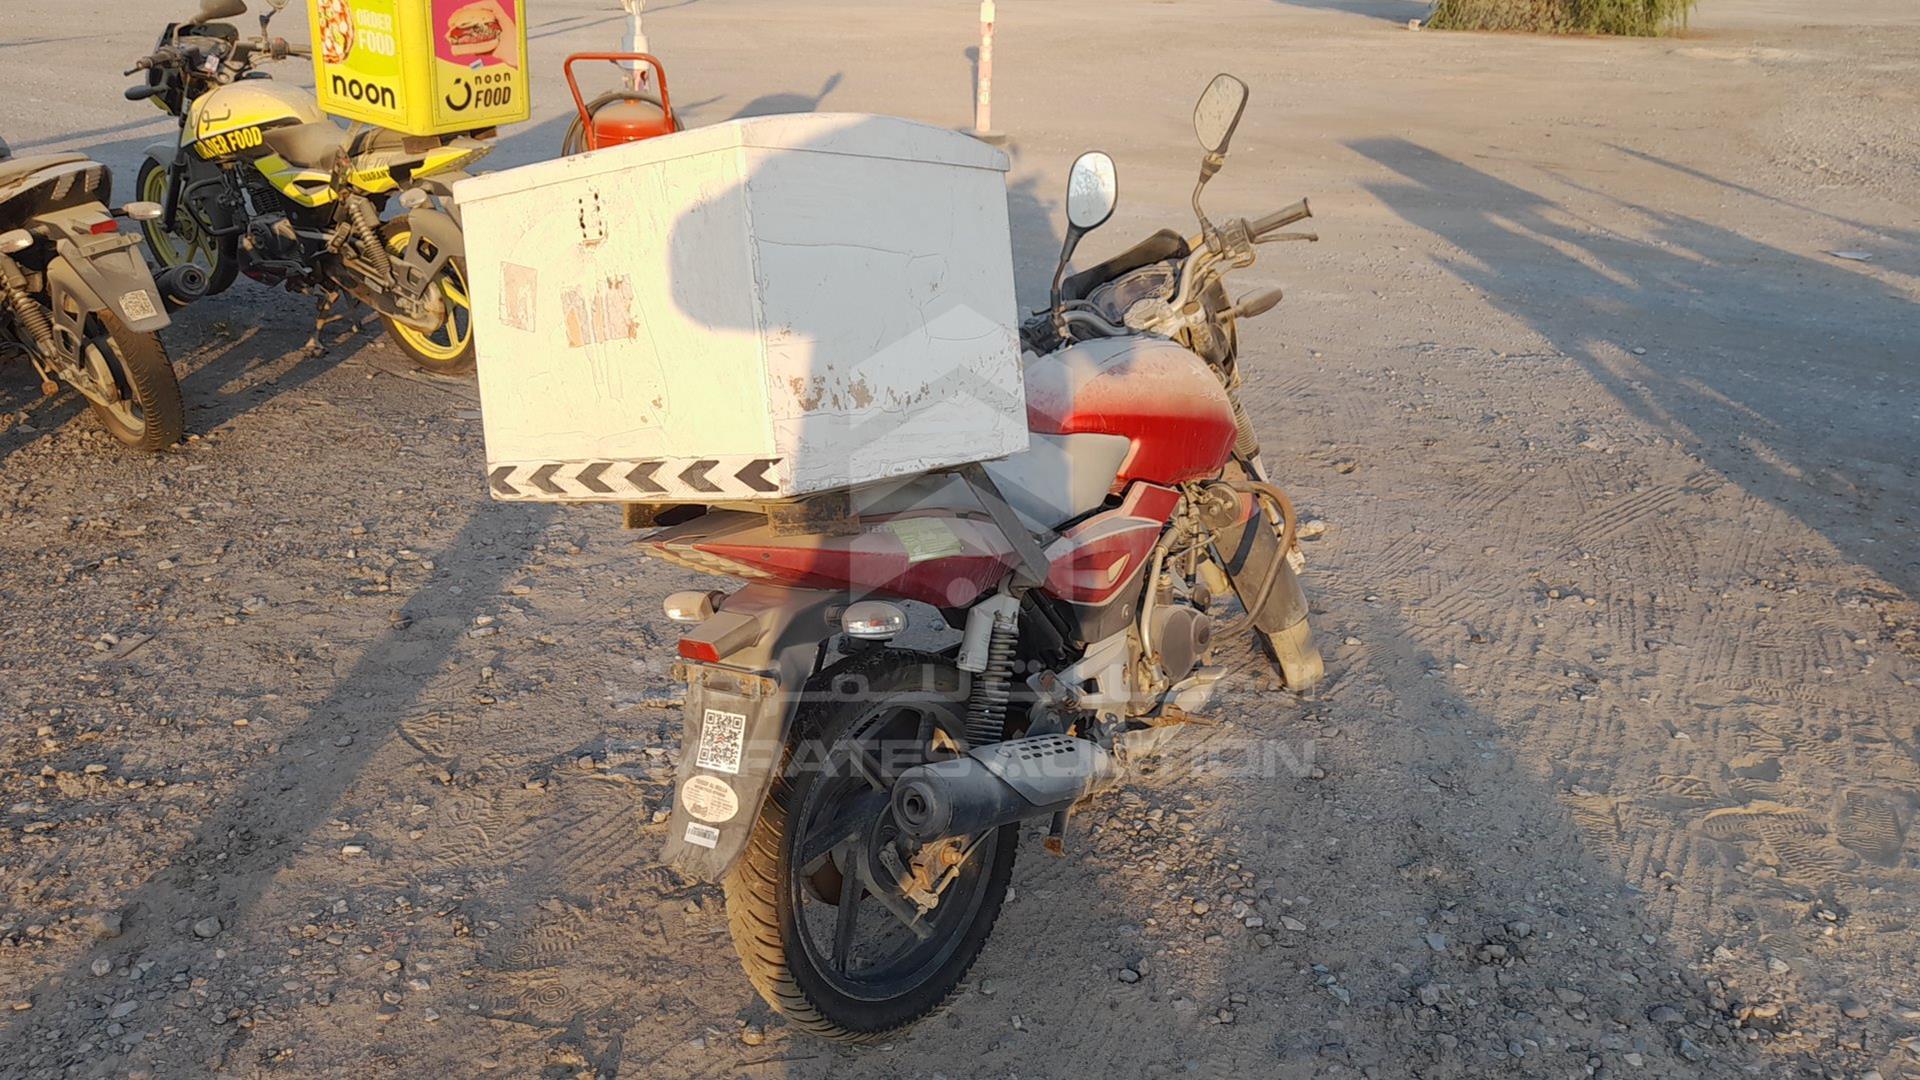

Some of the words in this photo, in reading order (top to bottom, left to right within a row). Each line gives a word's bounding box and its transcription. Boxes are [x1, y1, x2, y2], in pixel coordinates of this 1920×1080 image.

[357, 9, 392, 30] ORDER
[358, 29, 396, 57] FOOD
[475, 72, 511, 85] noon
[332, 74, 396, 110] noon
[475, 86, 511, 109] FOOD
[227, 126, 263, 151] FOOD
